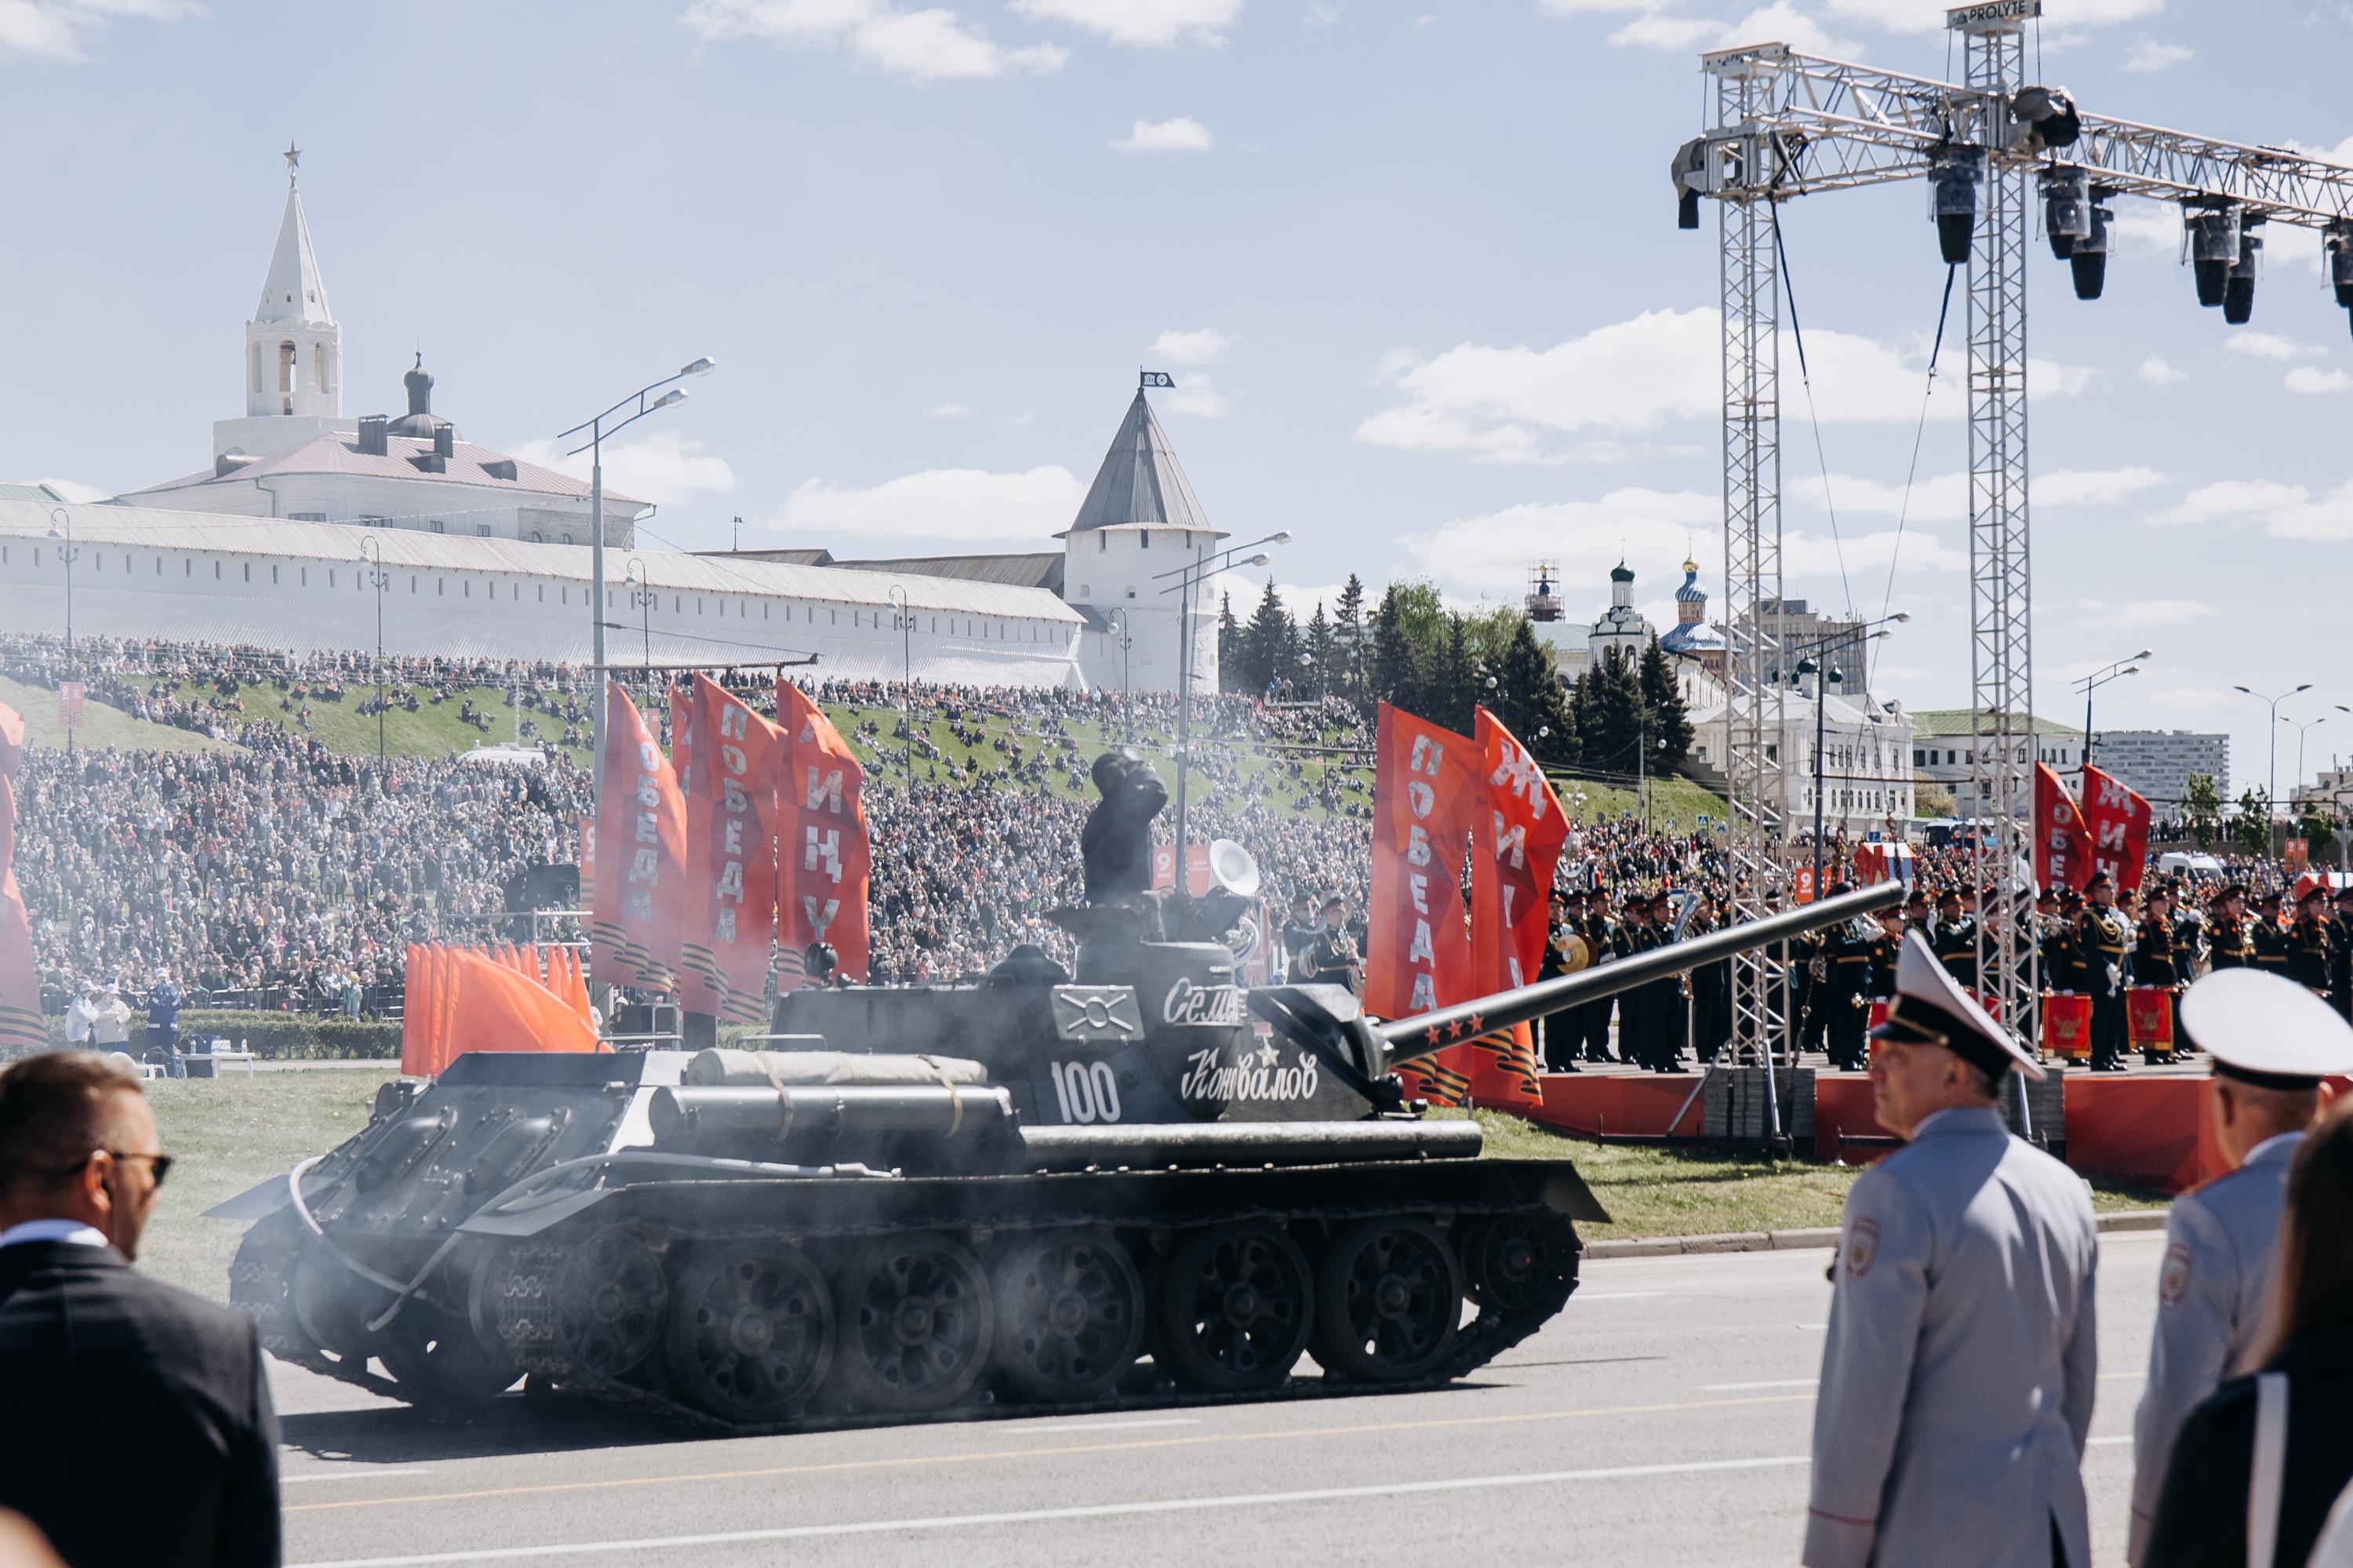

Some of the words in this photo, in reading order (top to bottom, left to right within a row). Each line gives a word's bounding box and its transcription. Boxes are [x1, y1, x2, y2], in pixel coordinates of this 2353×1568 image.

[1969, 1, 2025, 21] PROLYTE
[715, 702, 749, 944] ПОБЕДА
[1157, 852, 1171, 872] 9
[1408, 733, 1444, 1013] ПОБЕДА
[1801, 872, 1812, 889] 9
[1051, 1060, 1121, 1124] 100
[1181, 1047, 1318, 1101] Коновалов
